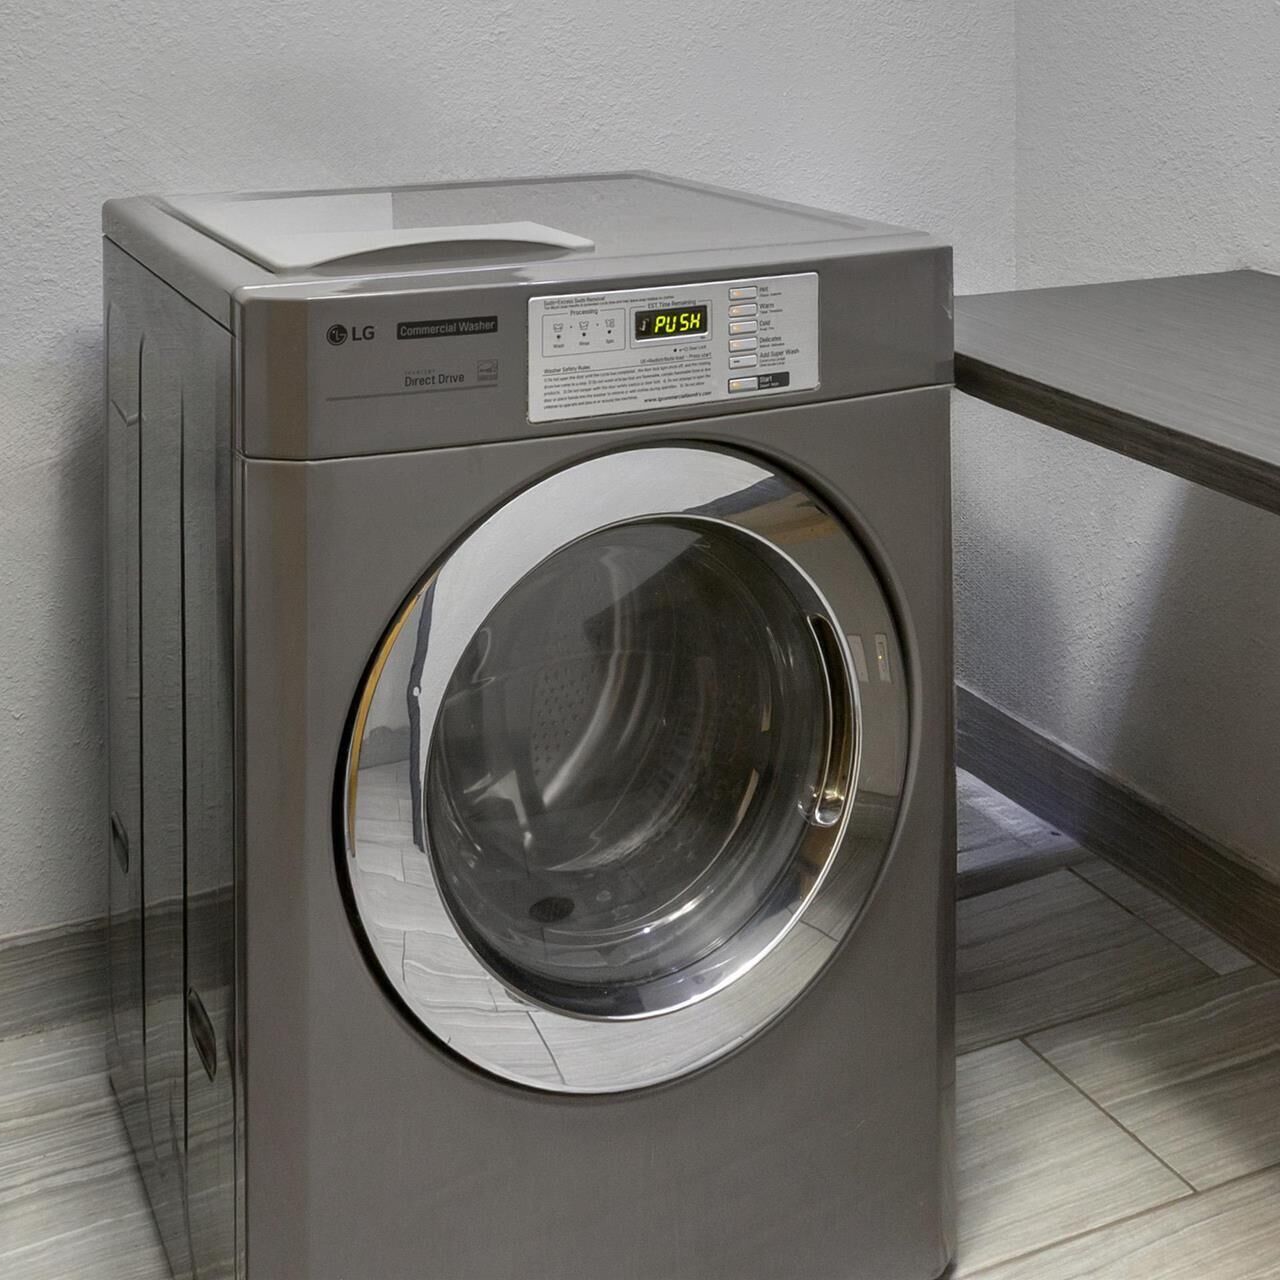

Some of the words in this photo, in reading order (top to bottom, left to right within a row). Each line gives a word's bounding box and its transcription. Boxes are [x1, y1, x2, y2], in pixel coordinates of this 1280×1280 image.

[570, 308, 599, 316] Processing
[399, 322, 457, 337] Commercial
[458, 320, 495, 332] Washer
[654, 312, 702, 333] PUSH
[351, 325, 376, 341] LG
[403, 375, 436, 388] Direct
[438, 373, 465, 385] Drive
